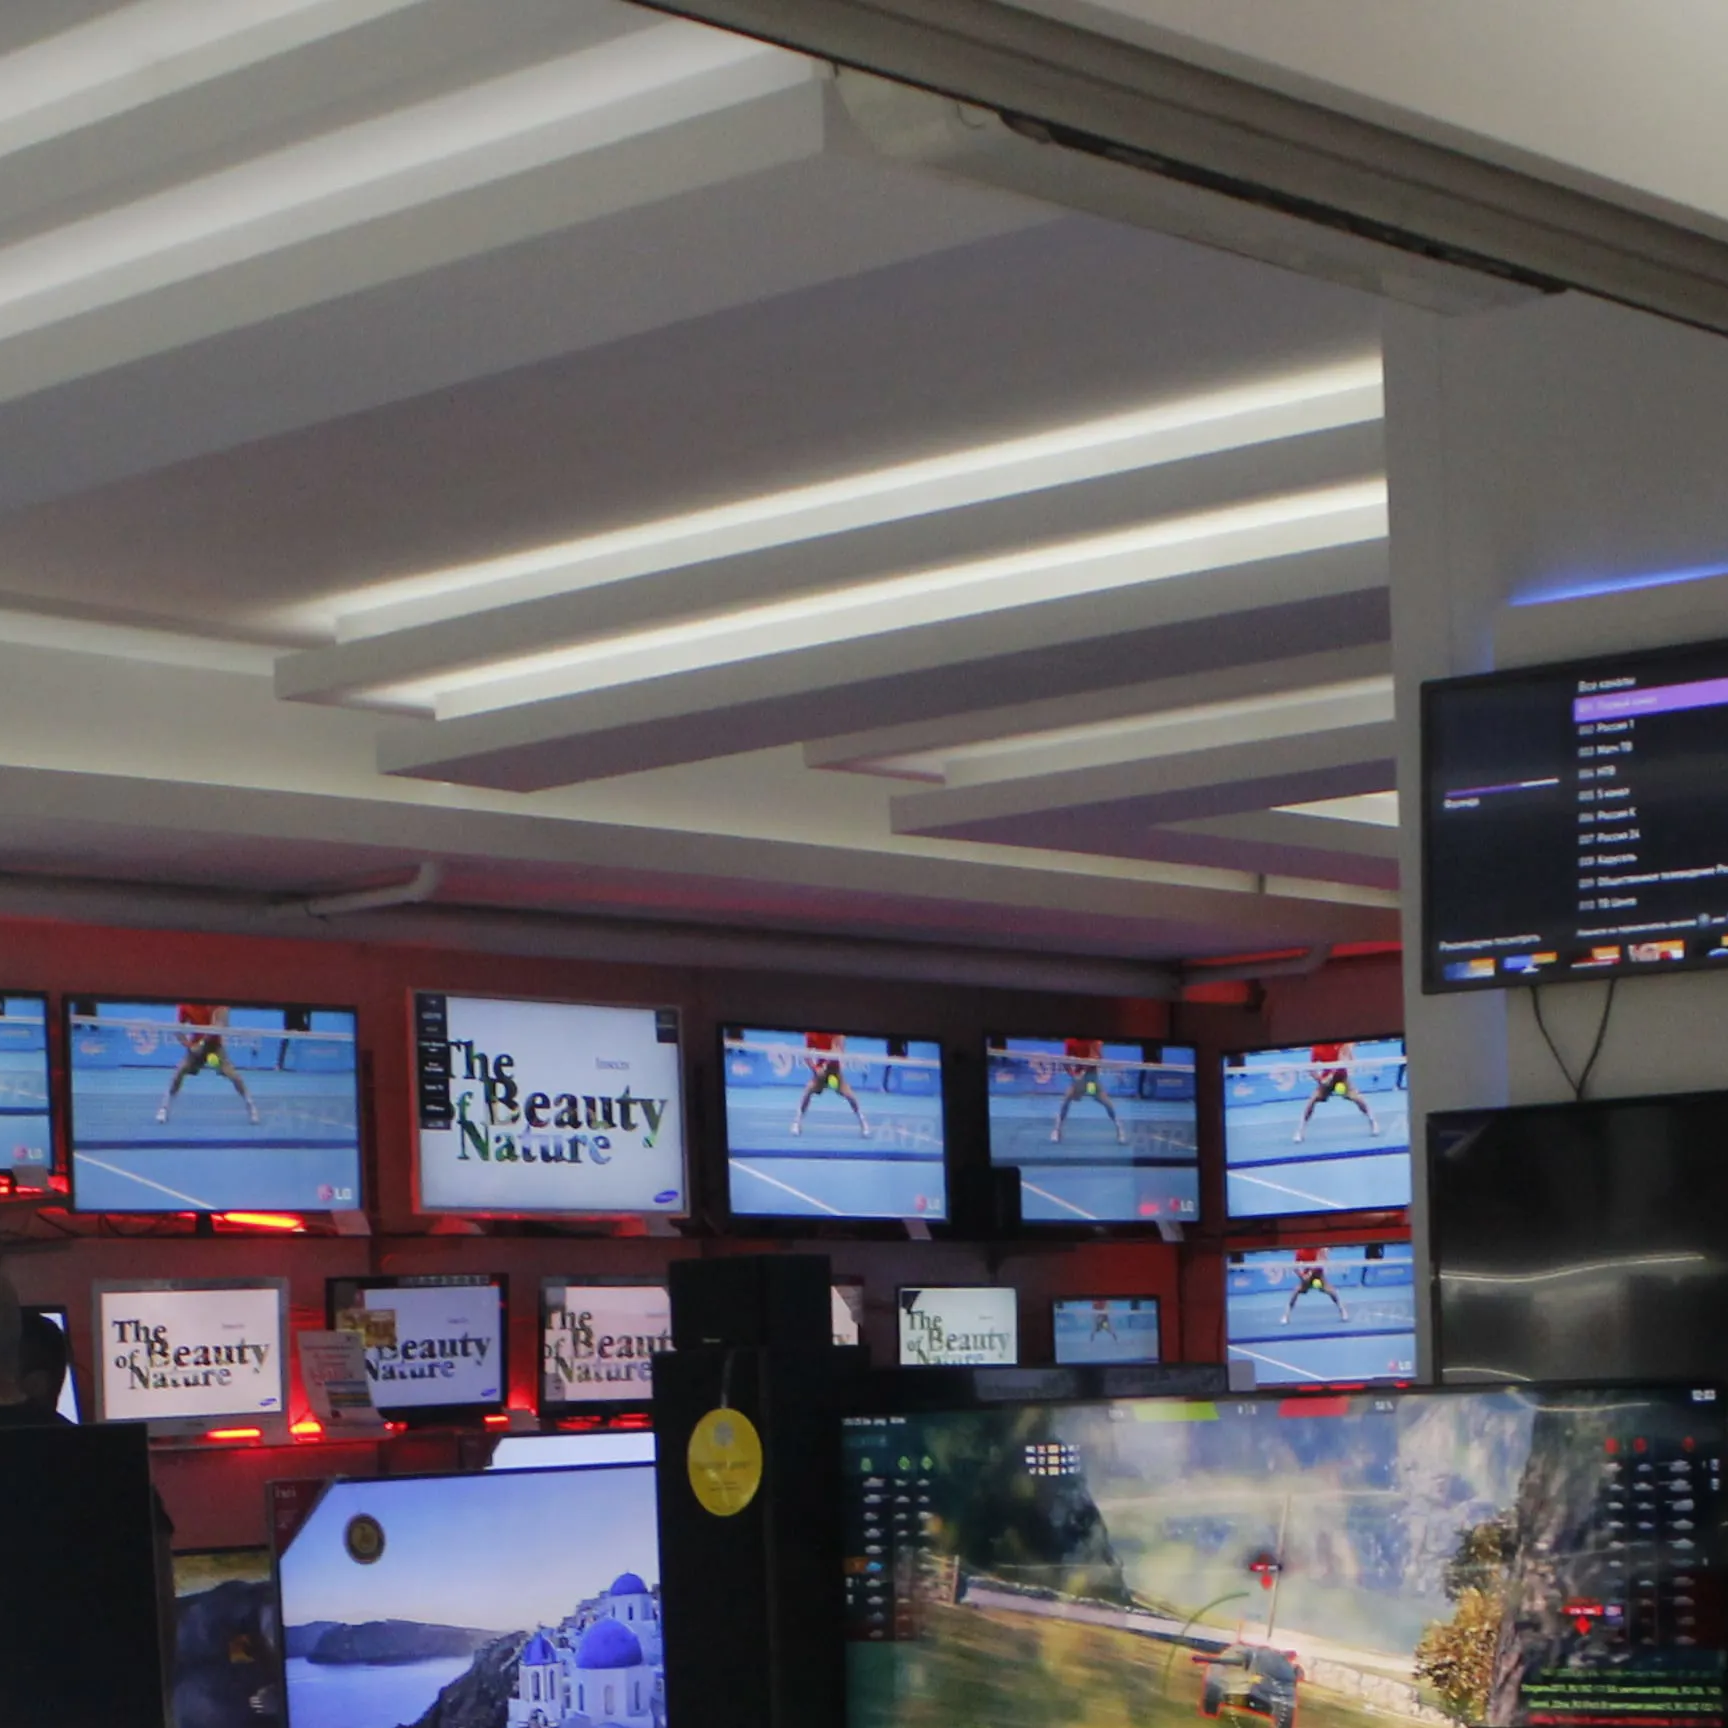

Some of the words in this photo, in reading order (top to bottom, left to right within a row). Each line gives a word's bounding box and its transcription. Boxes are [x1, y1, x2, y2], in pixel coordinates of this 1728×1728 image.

[484, 1077, 669, 1149] Beauty
[456, 1118, 613, 1166] Nature
[112, 1318, 168, 1344] The
[572, 1324, 671, 1360] Beaut
[147, 1337, 270, 1374] Beauty
[129, 1363, 233, 1390] Nature
